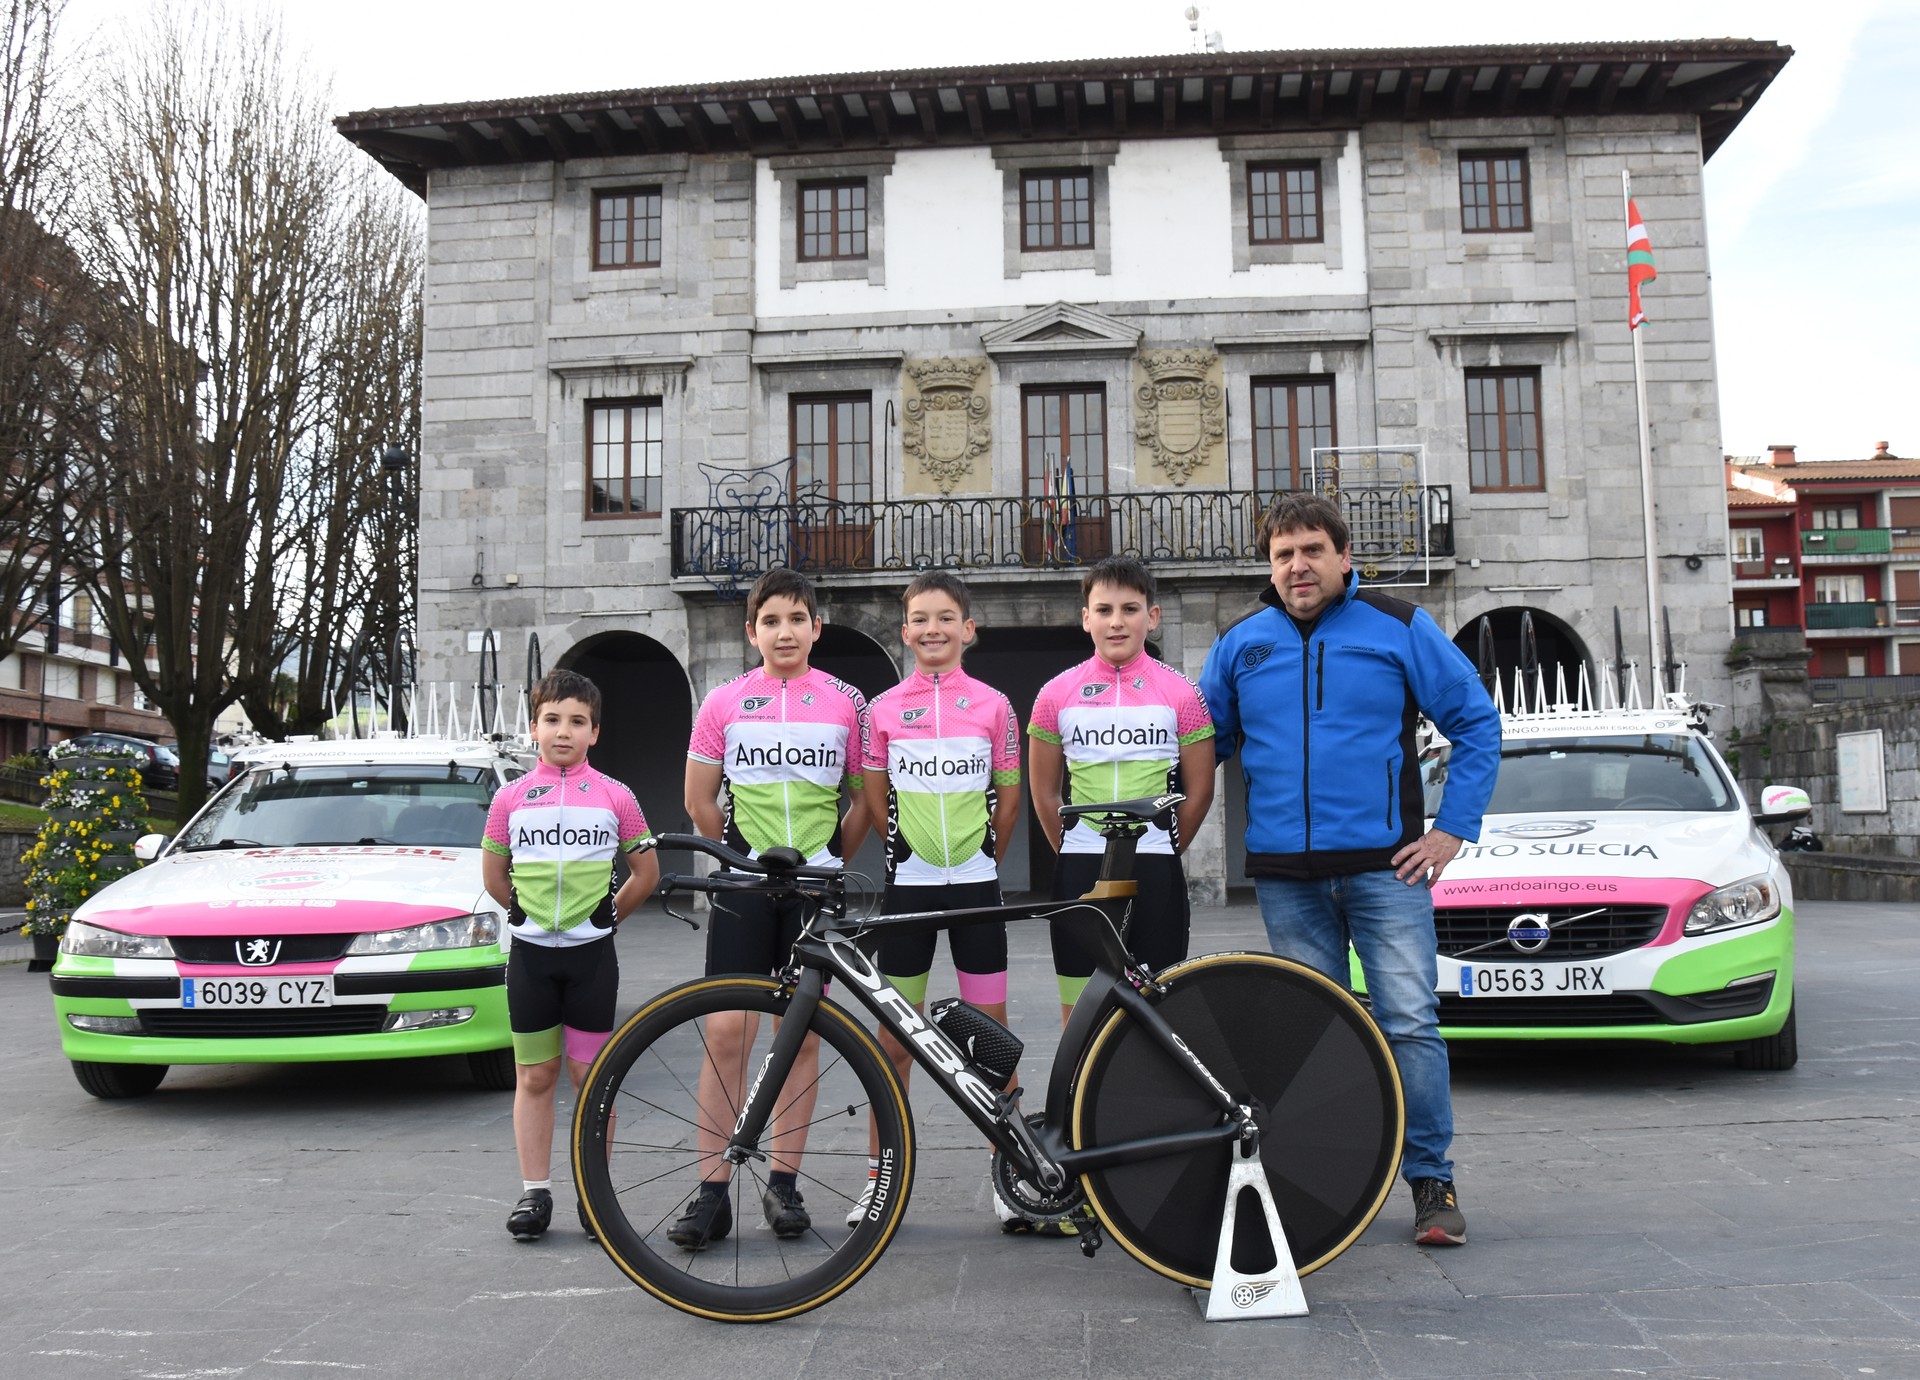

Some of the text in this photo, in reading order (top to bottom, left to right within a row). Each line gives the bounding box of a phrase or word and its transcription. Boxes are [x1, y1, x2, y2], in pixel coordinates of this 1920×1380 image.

[1071, 723, 1168, 745] Andoain
[1611, 724, 1647, 732] ESKOLA
[270, 751, 346, 759] ANDOAINGO
[735, 741, 837, 767] Andoain
[898, 754, 986, 777] Andoain
[518, 823, 610, 847] Andoain
[244, 847, 462, 859] MAPFRE
[1452, 843, 1659, 860] UTO SUECIA
[1443, 880, 1618, 896] www.andoaingo.eus
[1478, 969, 1544, 992] 0563
[1556, 967, 1606, 991] JRX
[202, 982, 264, 1004] 6039
[278, 981, 326, 1004] CYZ
[1171, 1032, 1231, 1104] ORBEA
[734, 1052, 775, 1135] ORBEA
[867, 1148, 893, 1222] SHIMANO
